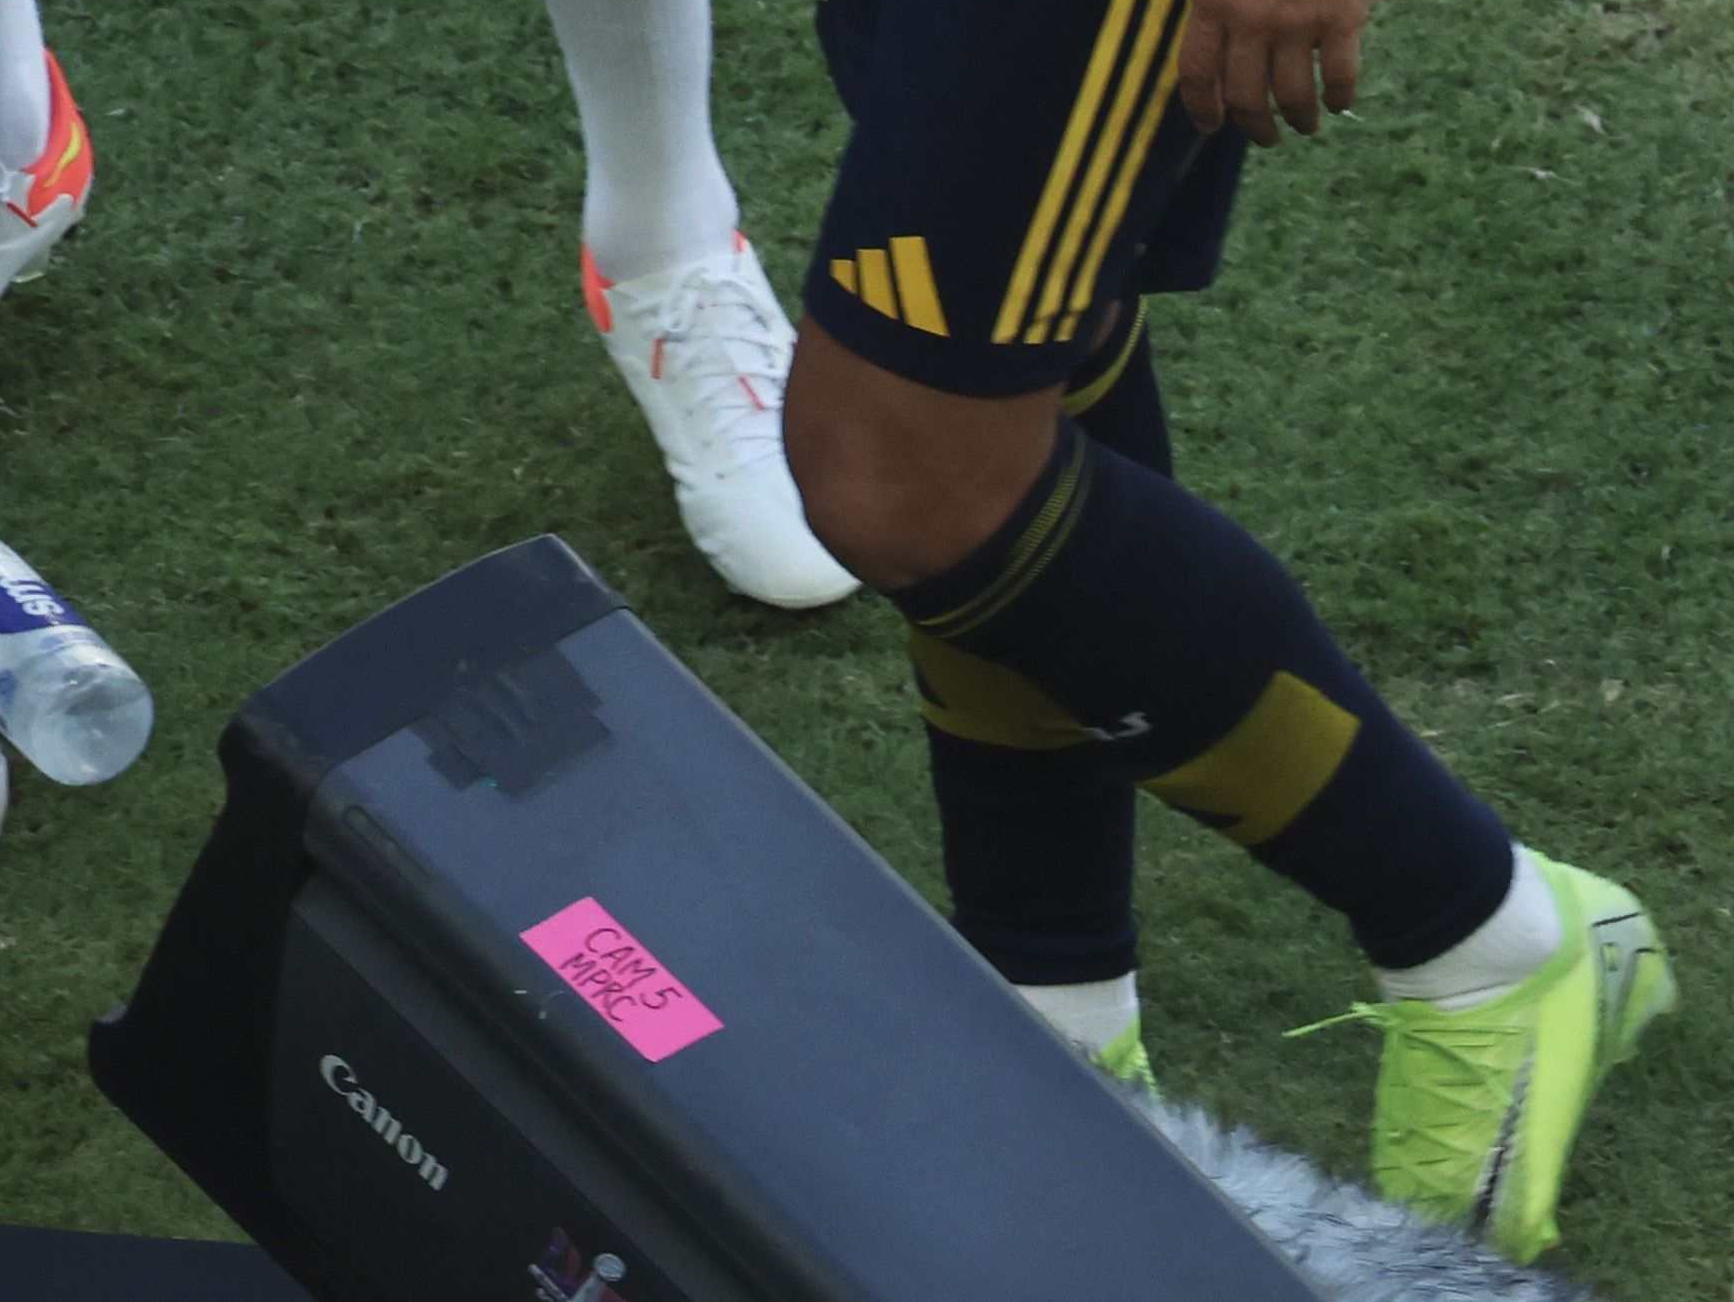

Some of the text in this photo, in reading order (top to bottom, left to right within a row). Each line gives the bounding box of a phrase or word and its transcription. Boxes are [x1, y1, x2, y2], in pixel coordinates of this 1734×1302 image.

[584, 927, 683, 1010] CAM 5
[319, 1053, 450, 1192] Canon
